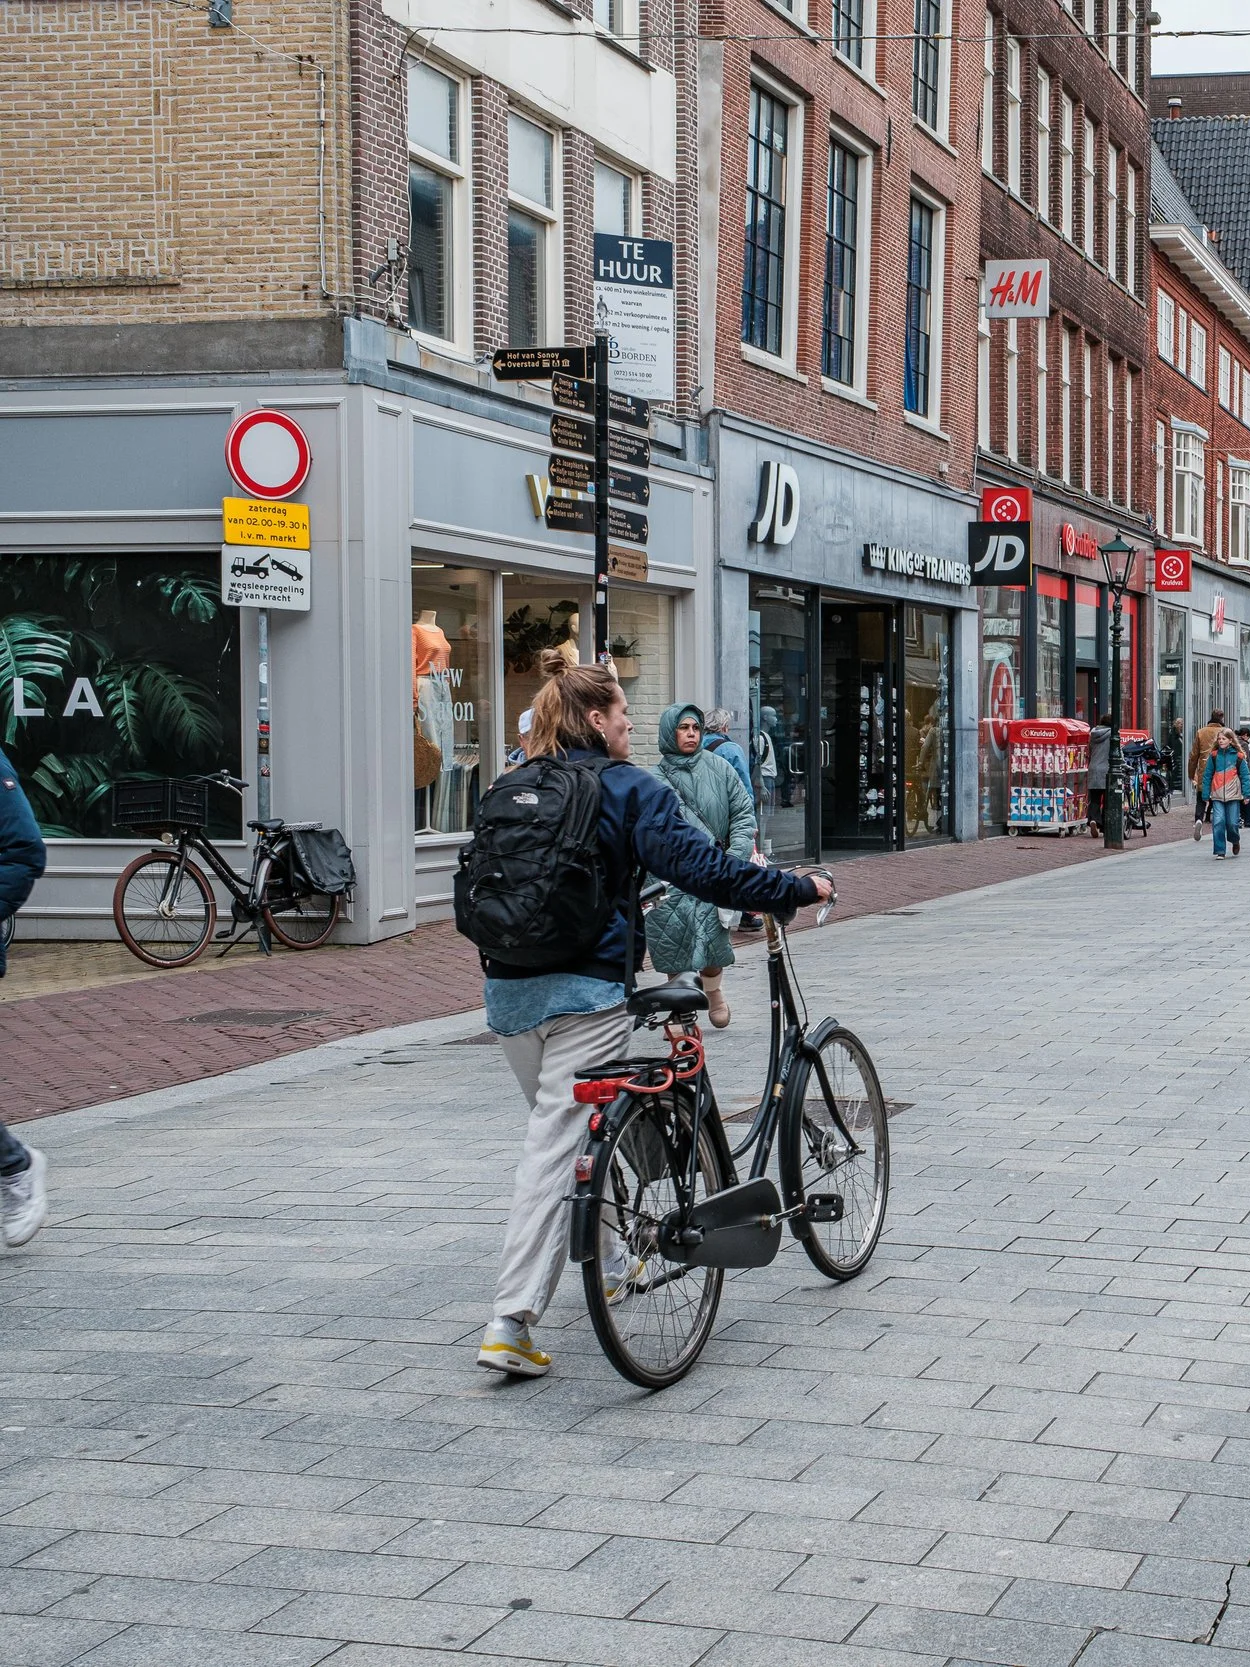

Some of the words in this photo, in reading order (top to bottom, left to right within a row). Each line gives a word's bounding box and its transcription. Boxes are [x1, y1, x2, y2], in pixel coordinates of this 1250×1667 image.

[618, 240, 645, 261] TE
[599, 259, 664, 284] HUUR
[989, 269, 1043, 308] H&M
[623, 311, 660, 321] verkoopruimte
[537, 351, 560, 360] Sonoy
[621, 351, 657, 362] BORDEN
[507, 360, 540, 368] Overstad
[755, 460, 801, 546] JD
[248, 504, 287, 517] zaterdag
[227, 517, 244, 525] van
[302, 522, 308, 531] h
[270, 534, 297, 543] markt
[974, 534, 1025, 573] JD
[888, 546, 914, 576] KING
[913, 552, 925, 571] OF
[924, 555, 972, 587] TRAINERS
[230, 581, 305, 596] wegsleepregeling
[1160, 579, 1184, 587] Kruidvat
[244, 592, 260, 600] van
[262, 592, 292, 602] kracht
[428, 660, 464, 689] New
[1029, 729, 1056, 738] Kruidvat
